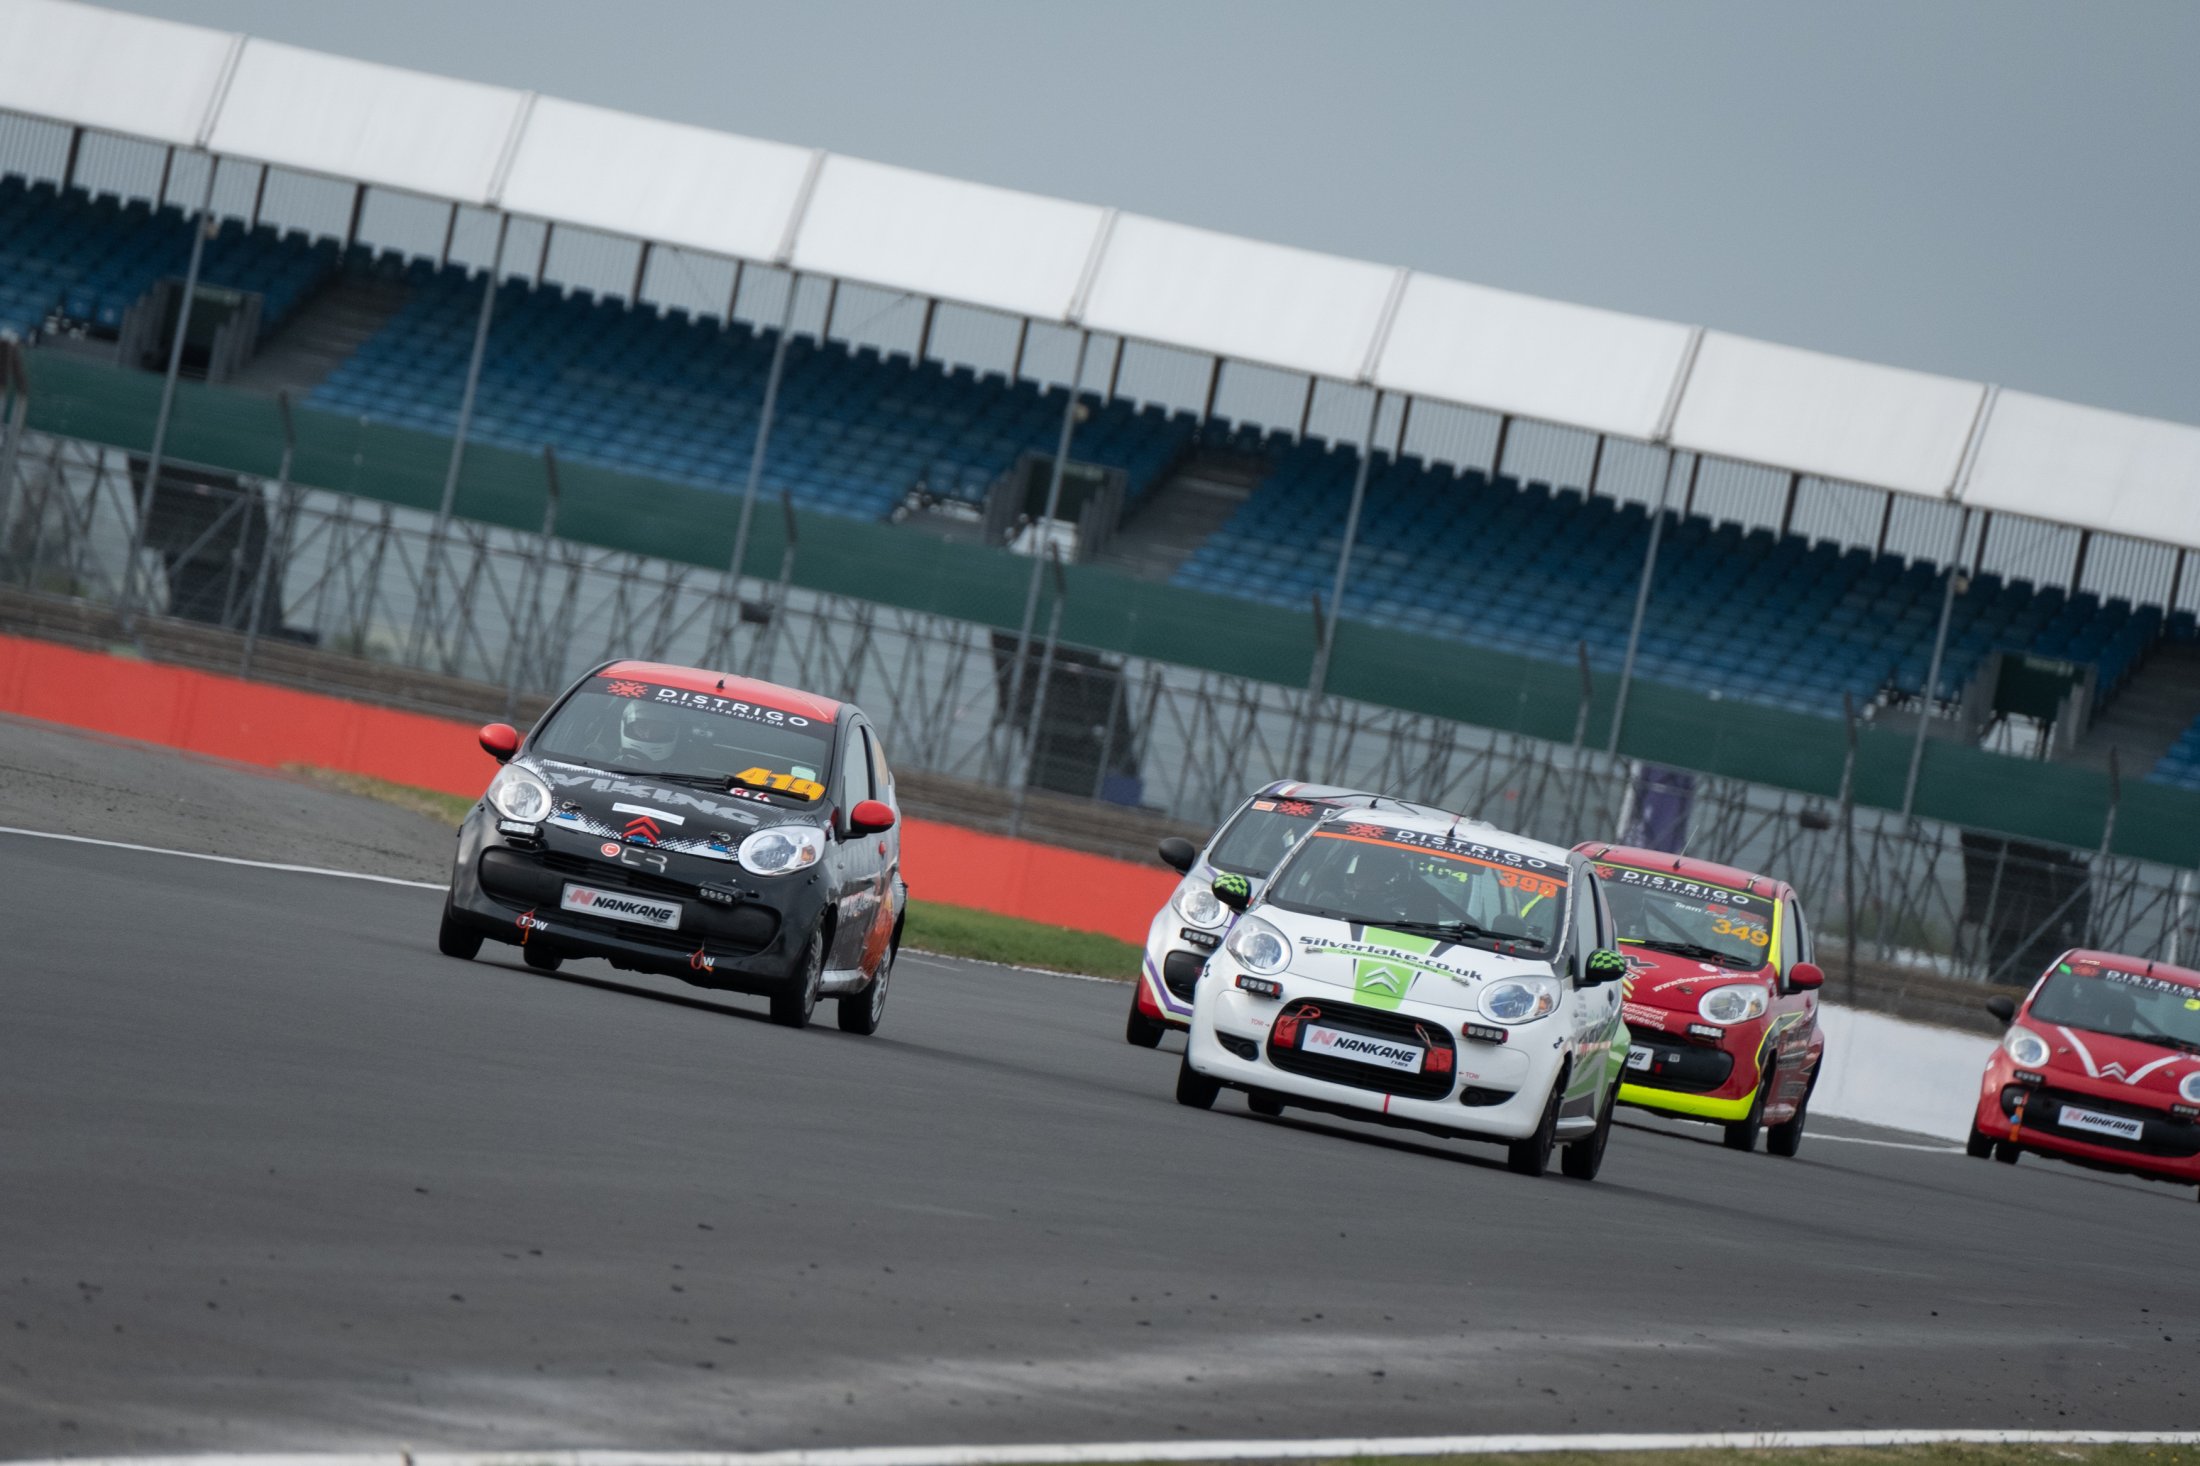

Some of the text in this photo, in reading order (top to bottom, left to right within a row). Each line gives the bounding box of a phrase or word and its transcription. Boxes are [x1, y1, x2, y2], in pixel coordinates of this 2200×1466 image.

[654, 697, 784, 727] PARTS DISTRIBUTION
[658, 688, 809, 727] DISTRIGO
[736, 767, 825, 800] 419
[549, 772, 760, 826] VIKING
[1394, 837, 1523, 868] PARTS DISTRIBUTION
[1397, 830, 1547, 868] DISTRIGO
[1499, 871, 1557, 898] 398
[1620, 878, 1729, 904] PARTS DISTRIBUTION
[1623, 870, 1750, 905] DISTRIGO
[592, 896, 674, 921] NANKANG
[1711, 918, 1769, 947] 349
[1299, 935, 1482, 981] Silverlake.co.uk
[2106, 969, 2200, 998] DISTRIG
[1333, 1036, 1417, 1063] NANKANG
[2081, 1115, 2138, 1132] NANKANG
